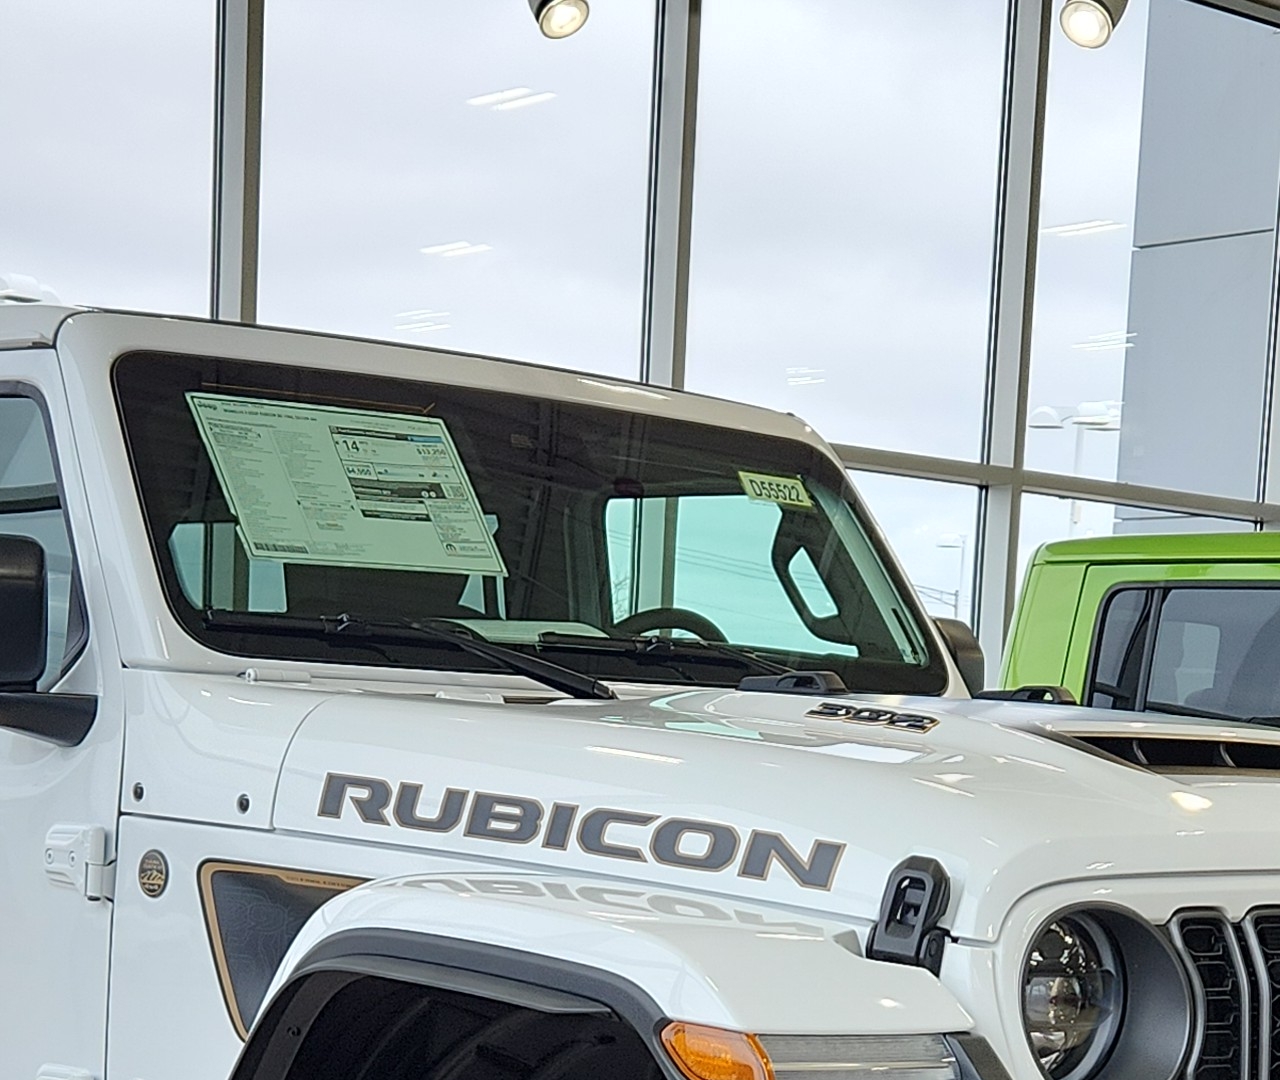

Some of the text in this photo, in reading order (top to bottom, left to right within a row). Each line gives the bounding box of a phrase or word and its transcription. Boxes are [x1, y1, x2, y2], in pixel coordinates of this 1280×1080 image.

[342, 439, 360, 452] 14
[748, 479, 804, 502] D55522
[804, 702, 940, 734] 392
[317, 771, 848, 891] RUBICON
